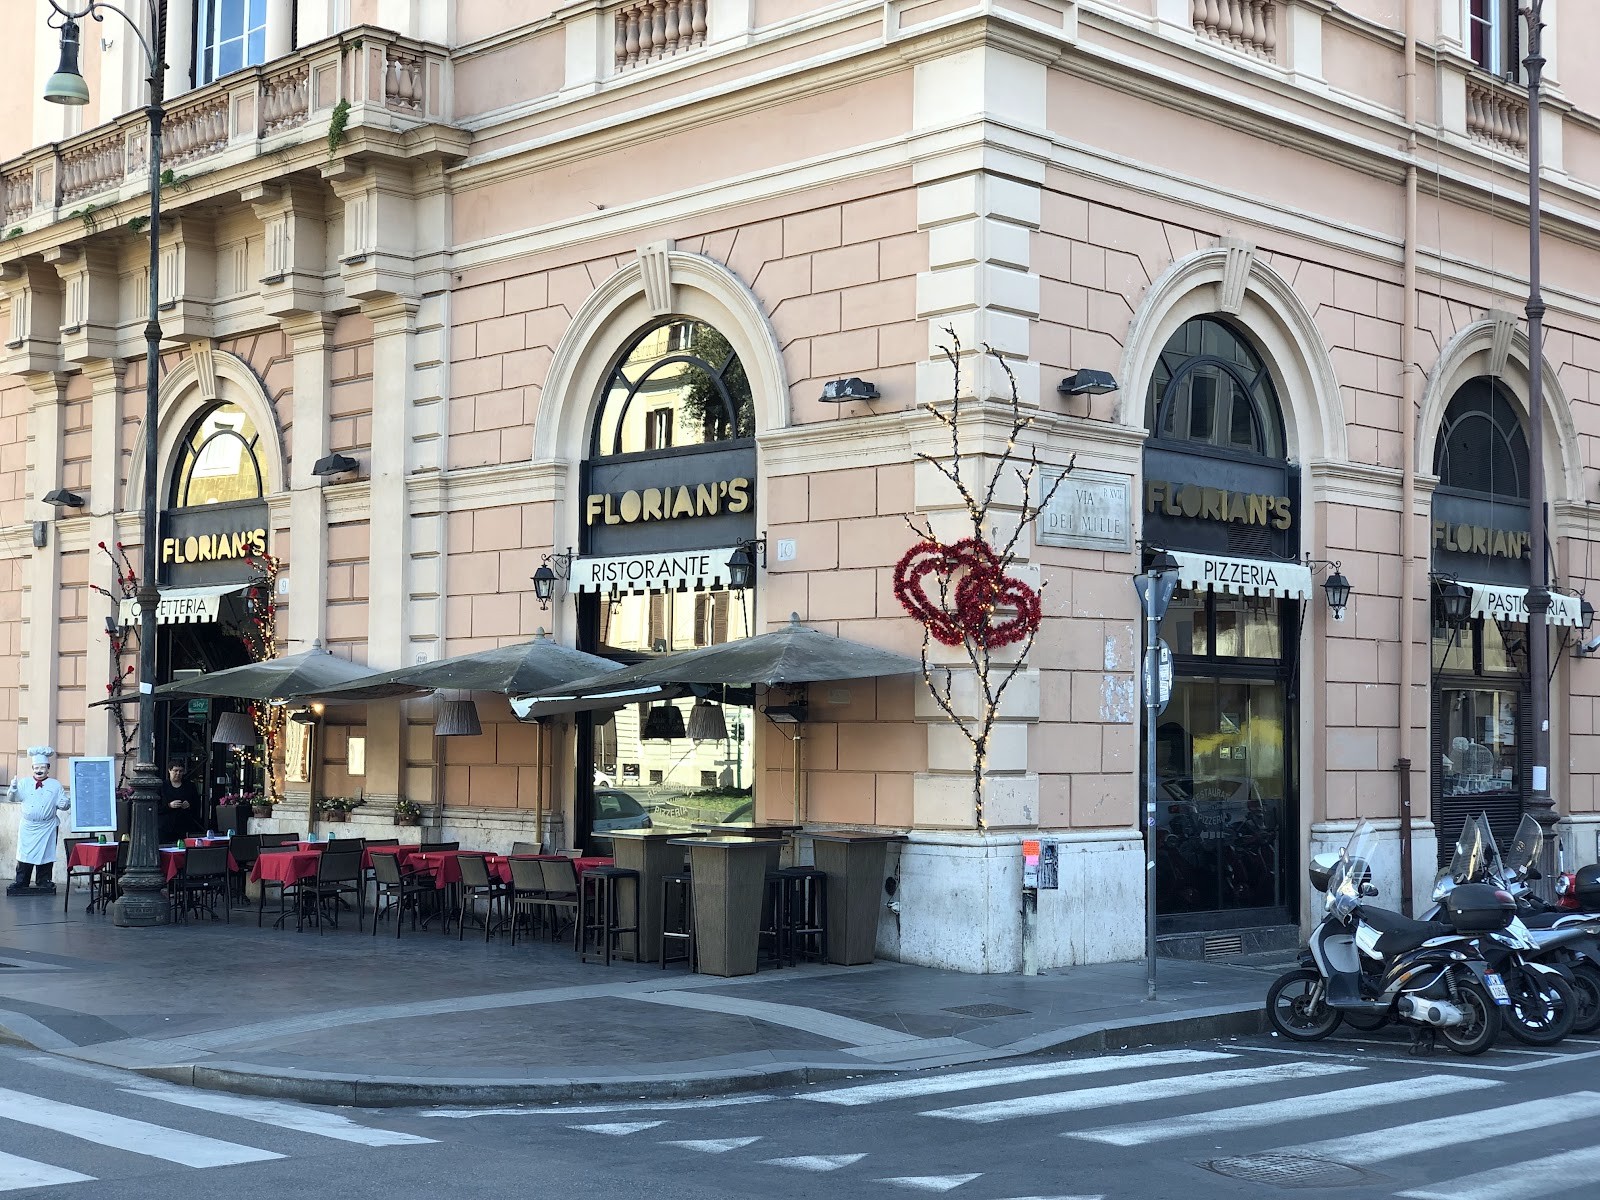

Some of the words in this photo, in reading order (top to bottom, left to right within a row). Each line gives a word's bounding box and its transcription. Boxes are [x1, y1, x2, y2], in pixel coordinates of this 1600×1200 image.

[587, 477, 749, 527] FLORIAN'S
[1076, 489, 1094, 506] VIA
[1147, 480, 1292, 530] FLORIAN'S
[1049, 512, 1072, 529] DEI
[1082, 516, 1120, 534] MILLE
[162, 528, 266, 564] FLORIAN'S
[780, 542, 793, 558] 10
[591, 555, 710, 582] RISTORANTE
[1204, 560, 1279, 587] PIZZERIA
[131, 598, 207, 617] CETTERIA
[1487, 592, 1568, 617] PASTICRIA
[192, 701, 205, 709] sky
[654, 805, 688, 818] PIZZERIA
